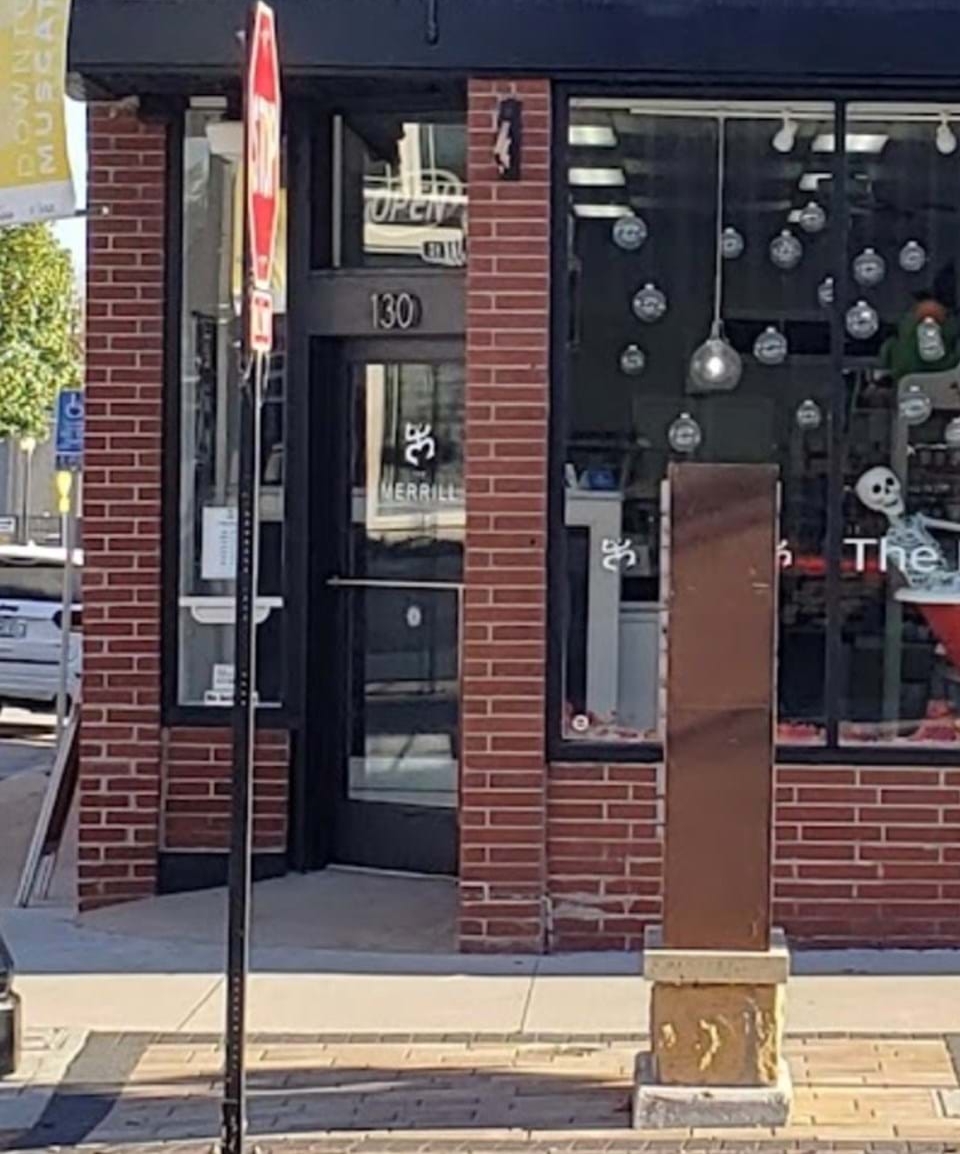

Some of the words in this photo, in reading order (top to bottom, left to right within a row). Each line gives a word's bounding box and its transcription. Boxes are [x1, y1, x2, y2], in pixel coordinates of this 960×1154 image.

[370, 292, 414, 329] 130
[380, 481, 458, 502] MERRILL
[842, 537, 939, 574] The
